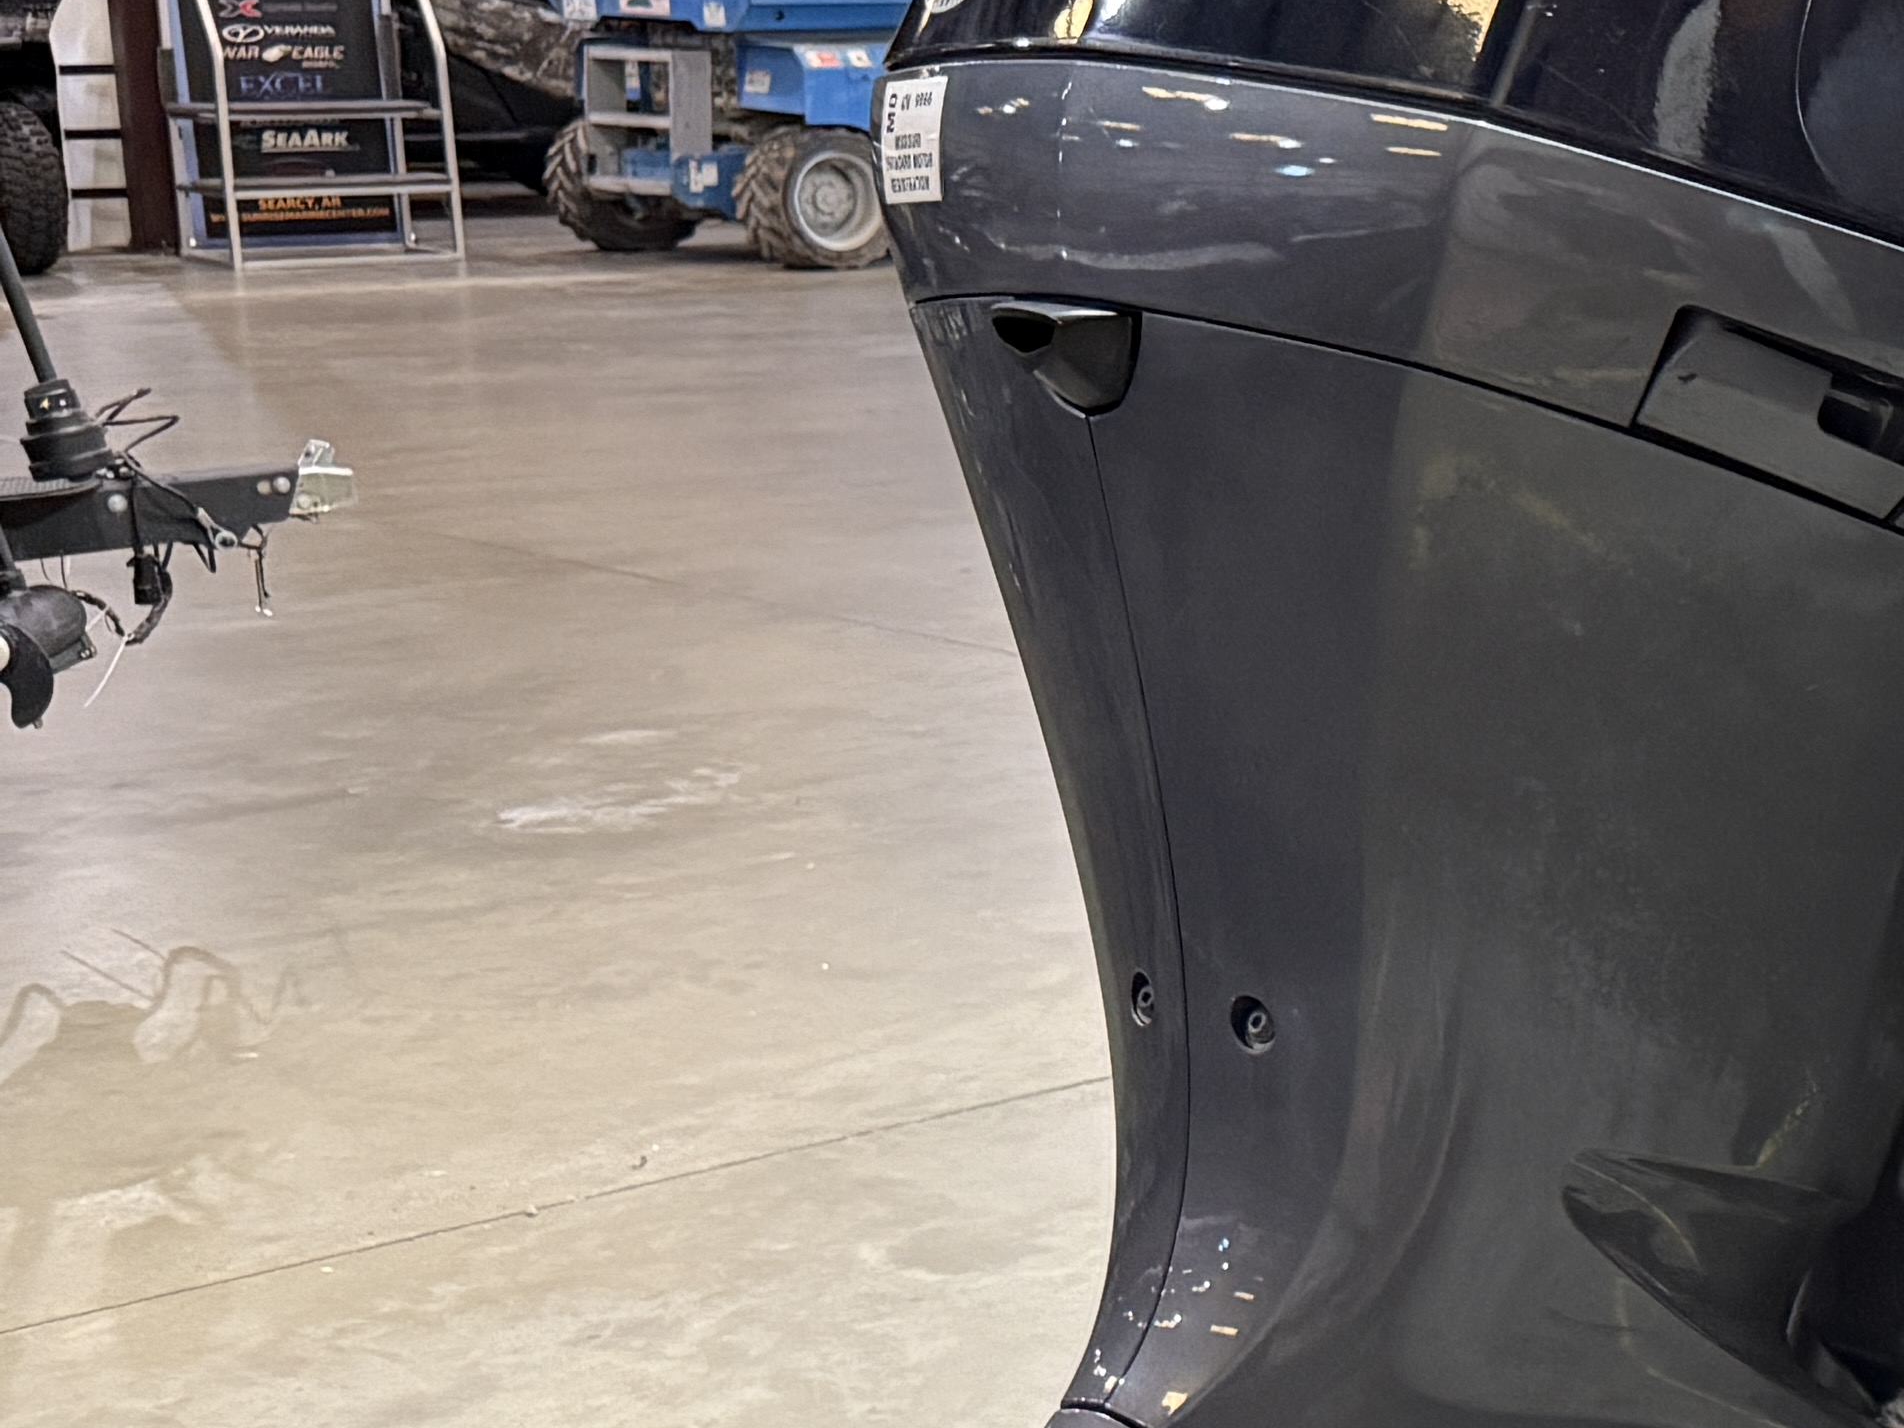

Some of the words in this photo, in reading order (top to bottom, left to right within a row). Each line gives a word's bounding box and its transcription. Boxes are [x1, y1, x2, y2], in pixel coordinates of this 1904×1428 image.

[222, 45, 260, 60] WAR
[291, 45, 345, 60] EAGLE
[239, 73, 325, 94] EXCEL
